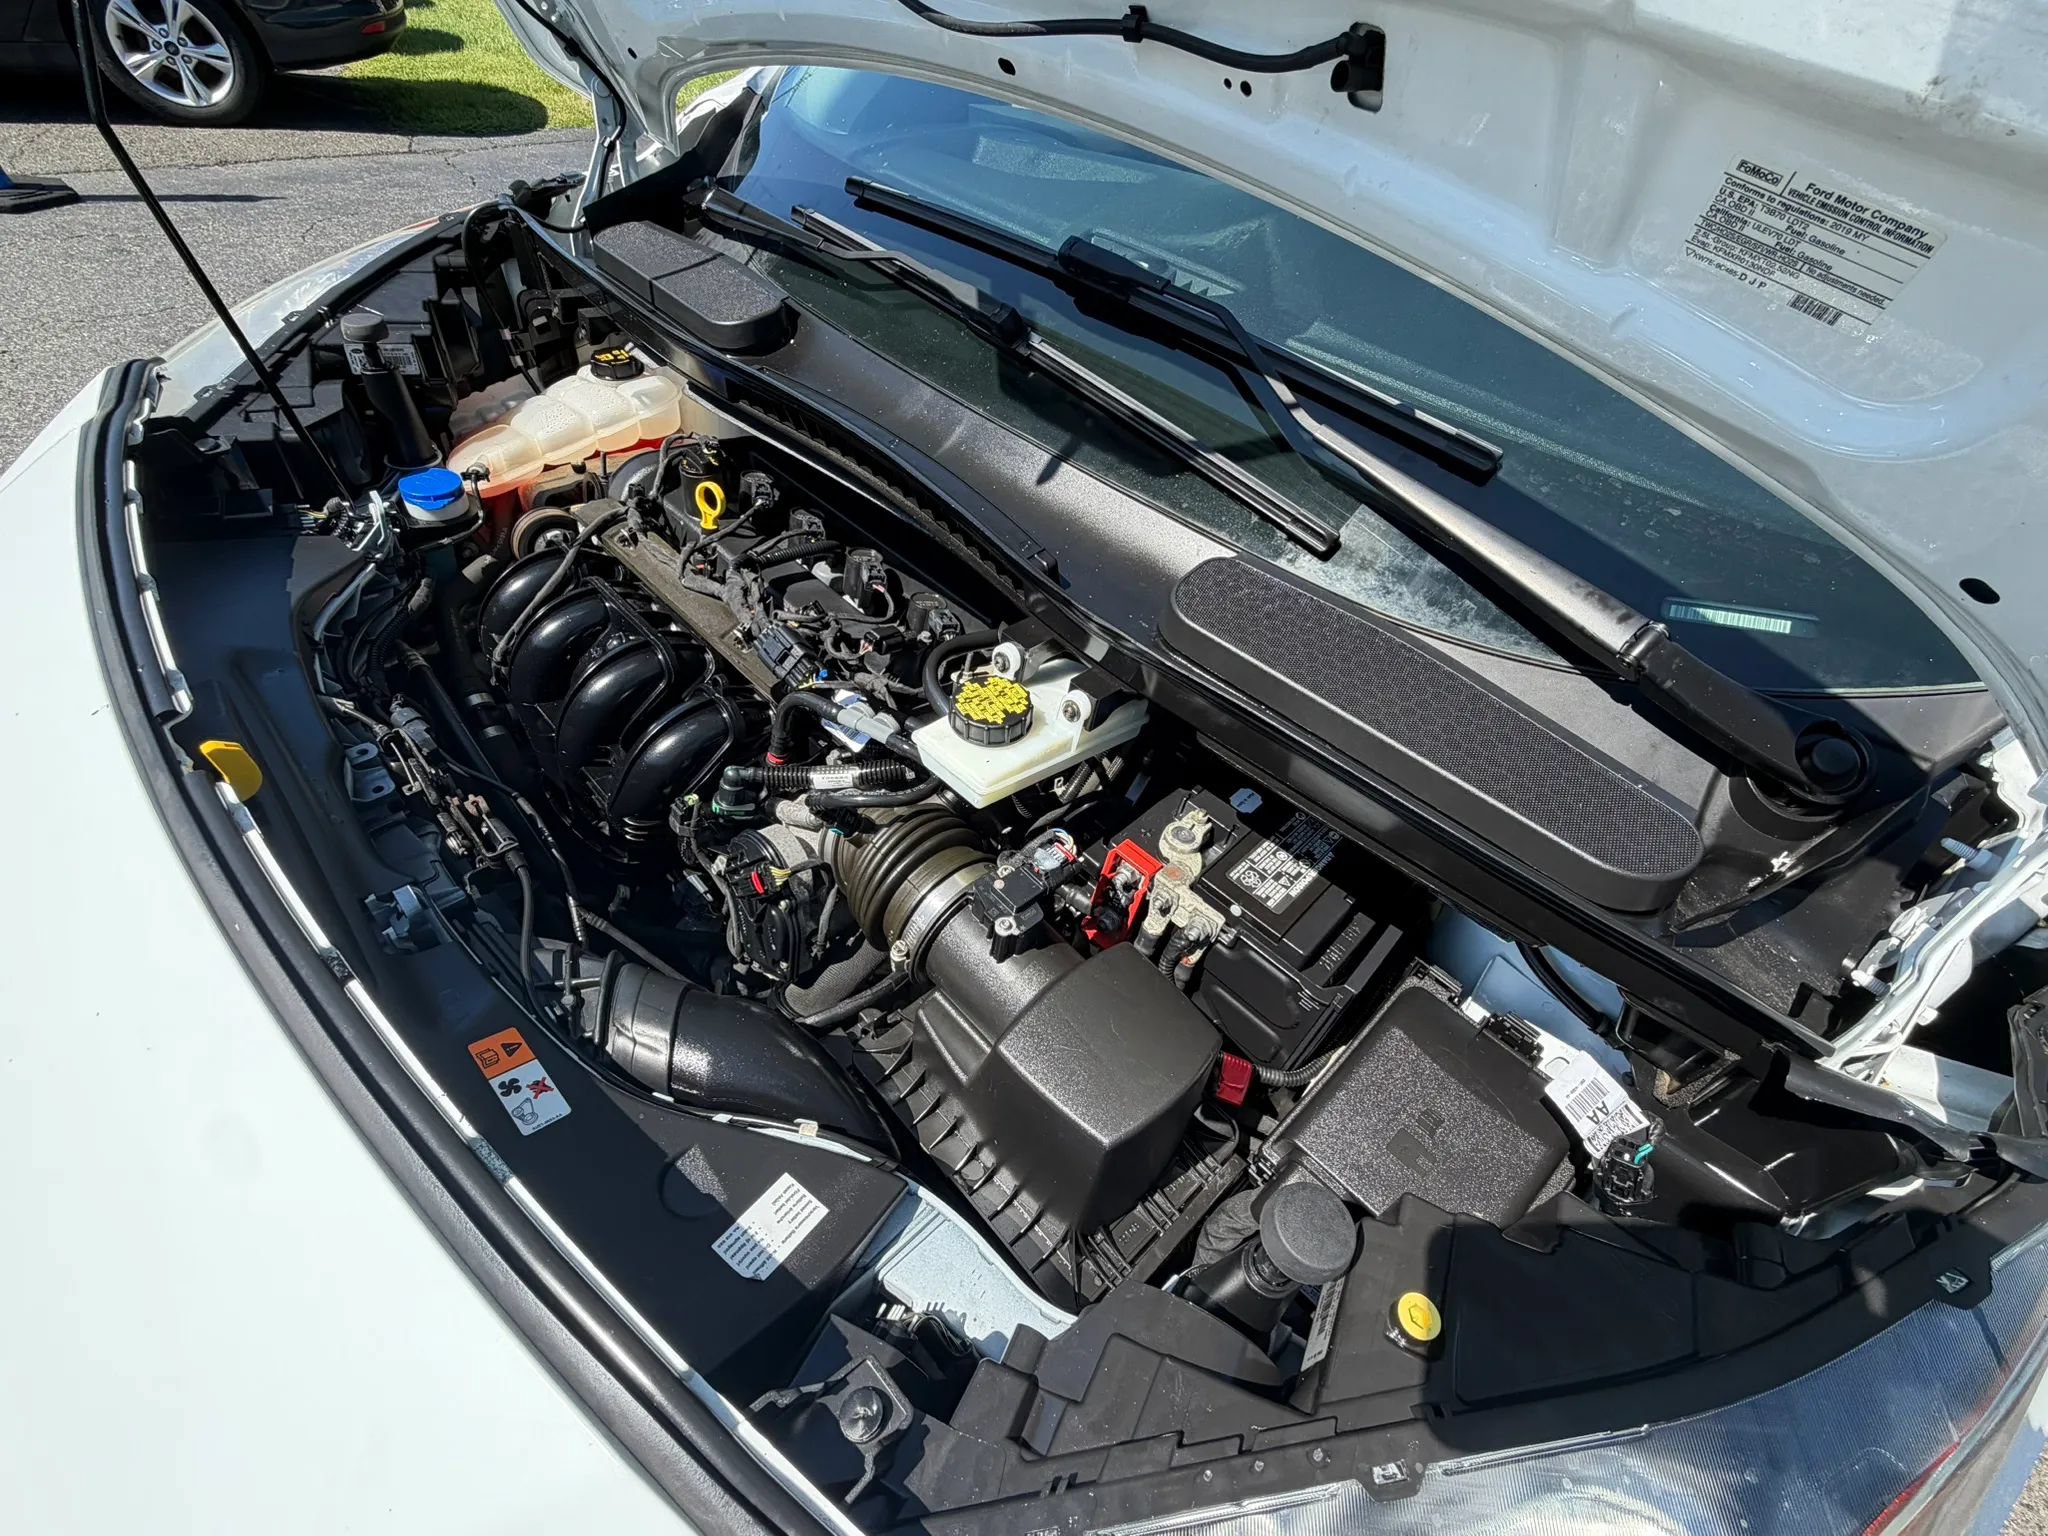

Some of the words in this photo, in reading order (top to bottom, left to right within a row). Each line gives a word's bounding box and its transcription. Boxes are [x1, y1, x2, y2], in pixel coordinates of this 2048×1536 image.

[1738, 160, 1780, 186] FoMoCo
[1709, 204, 1751, 228] California:
[1751, 222, 1784, 241] ULEV70
[1783, 235, 1801, 248] LDT
[1714, 194, 1727, 204] CA
[1728, 200, 1748, 213] OBD
[1785, 224, 1808, 240] Fuel:
[1808, 234, 1846, 256] Gasoline
[1719, 187, 1736, 200] U.S.
[1737, 195, 1758, 209] EPA:
[1760, 204, 1786, 220] T3B70
[1786, 216, 1810, 231] LDT2
[1724, 177, 1766, 199] Conforms
[1767, 195, 1777, 204] to
[1777, 200, 1829, 226] regulations:
[1829, 221, 1852, 236] 2019
[1852, 230, 1870, 243] MY
[1787, 188, 1817, 205] VEHICLE
[1815, 199, 1849, 219] EMISSION
[1849, 214, 1882, 233] CONTROL
[1882, 227, 1935, 254] INFORMATION
[1805, 182, 1835, 200] Ford
[1834, 194, 1870, 215] Motor
[1871, 210, 1928, 239] Company
[1691, 235, 1713, 249] Evap:
[1705, 210, 1718, 220] CA
[1719, 216, 1738, 229] OBD
[1774, 241, 1797, 257] Fuel:
[1797, 251, 1833, 271] Gasoline
[1805, 266, 1817, 276] No
[1816, 270, 1858, 294] adjustments
[1857, 289, 1886, 305] needed.
